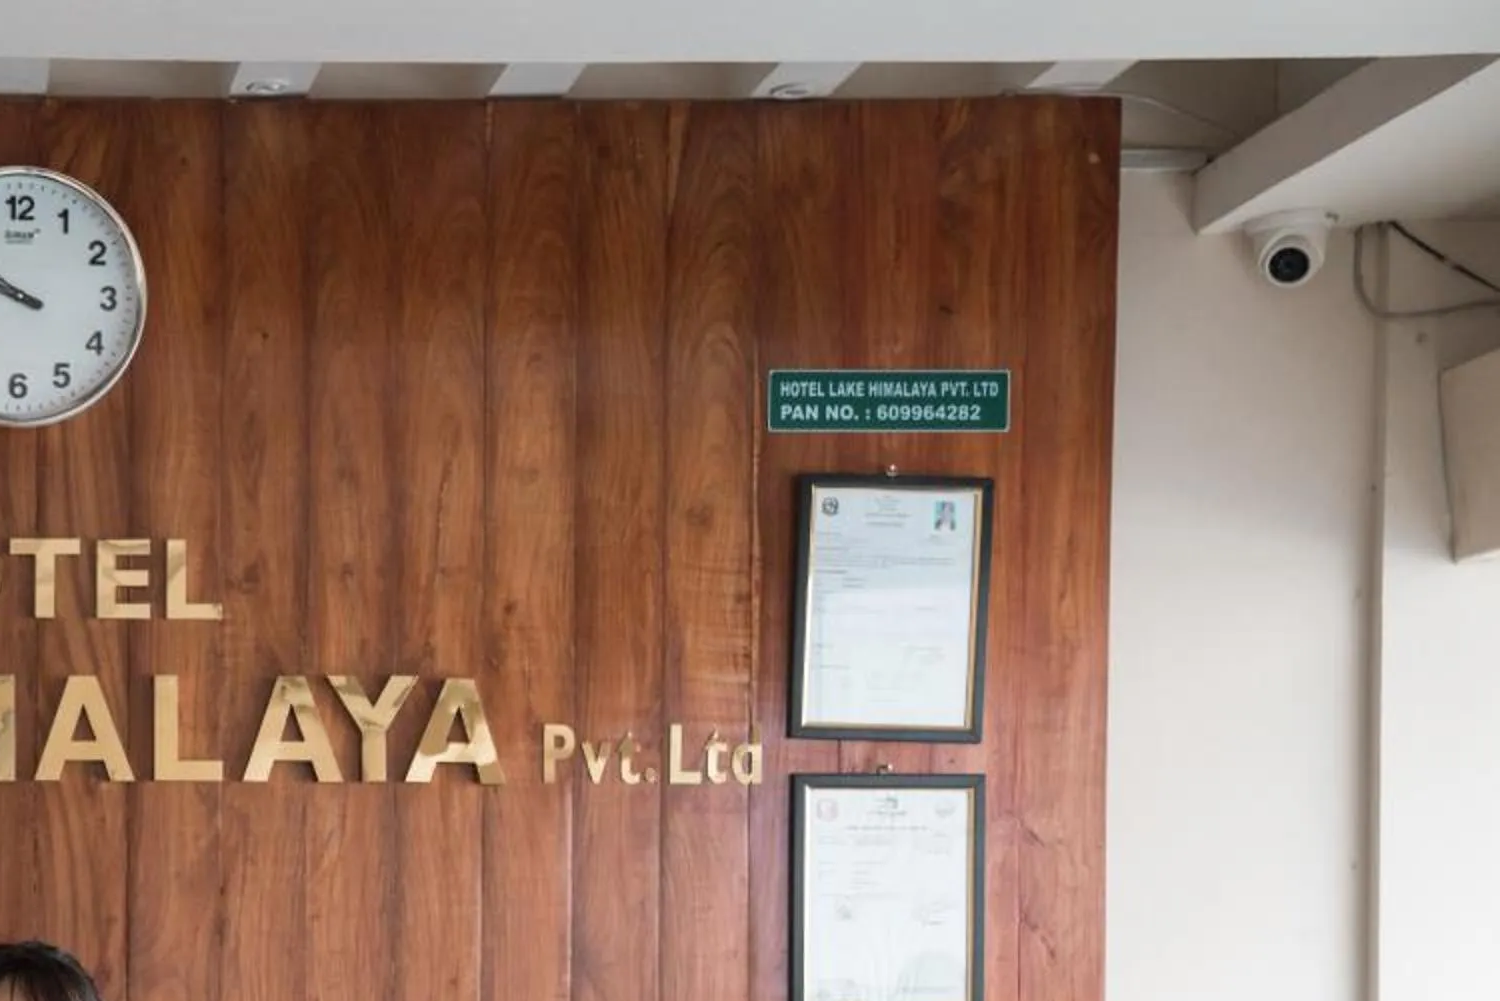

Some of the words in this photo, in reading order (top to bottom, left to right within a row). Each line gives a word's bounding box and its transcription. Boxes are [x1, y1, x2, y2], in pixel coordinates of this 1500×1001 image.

[5, 195, 35, 221] 12
[57, 208, 70, 234] 1
[88, 240, 107, 266] 2
[99, 286, 117, 311] 3
[85, 331, 104, 355] 4
[8, 373, 28, 399] 6
[52, 363, 71, 388] 5
[779, 381, 825, 397] HOTEL
[828, 381, 865, 397] LAKE
[868, 381, 937, 397] HIMALAYA
[941, 382, 970, 397] PVT.
[973, 382, 999, 397] LTD
[780, 404, 819, 421] PAN
[825, 404, 860, 421] NO.
[876, 404, 982, 421] 609964282
[542, 723, 659, 786] Pvt.
[669, 723, 763, 786] Ltd
